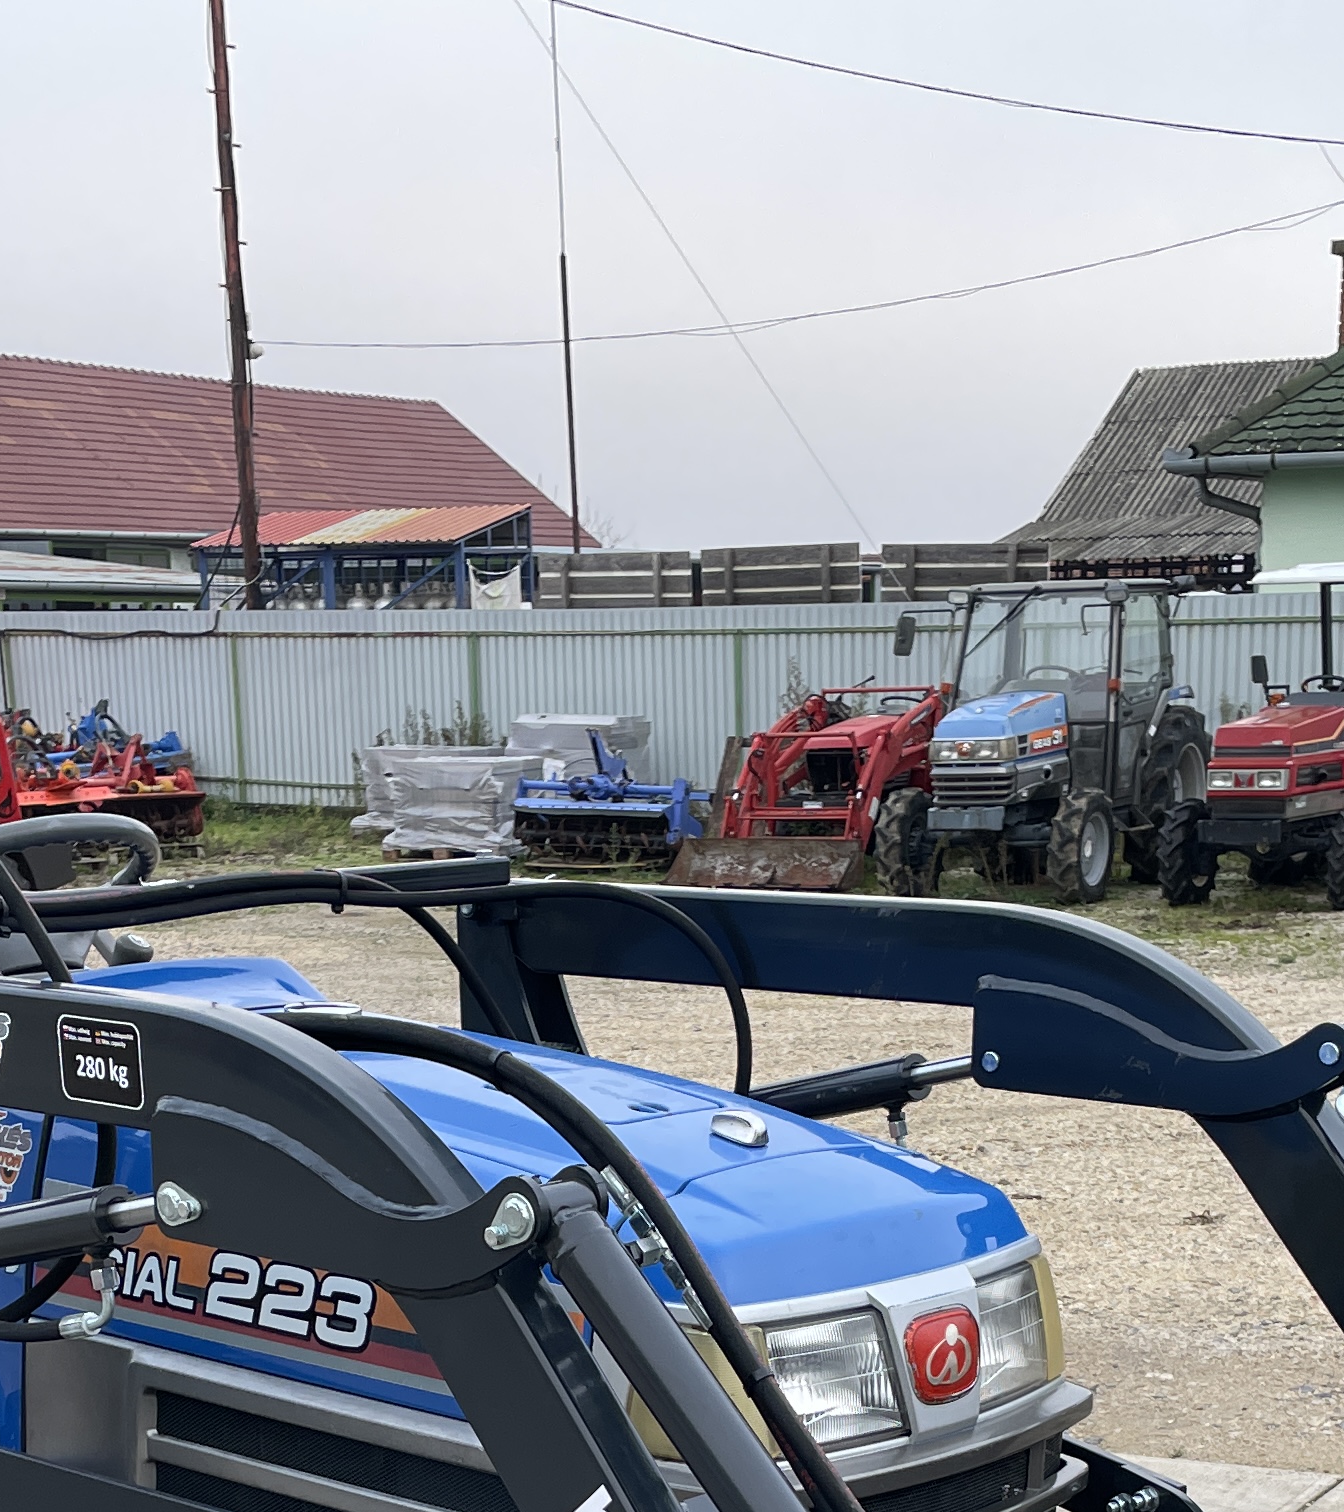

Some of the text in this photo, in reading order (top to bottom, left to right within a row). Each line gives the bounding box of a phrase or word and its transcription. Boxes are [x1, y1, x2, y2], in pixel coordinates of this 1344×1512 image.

[75, 1053, 129, 1089] 280 kg
[205, 1251, 376, 1350] 223
